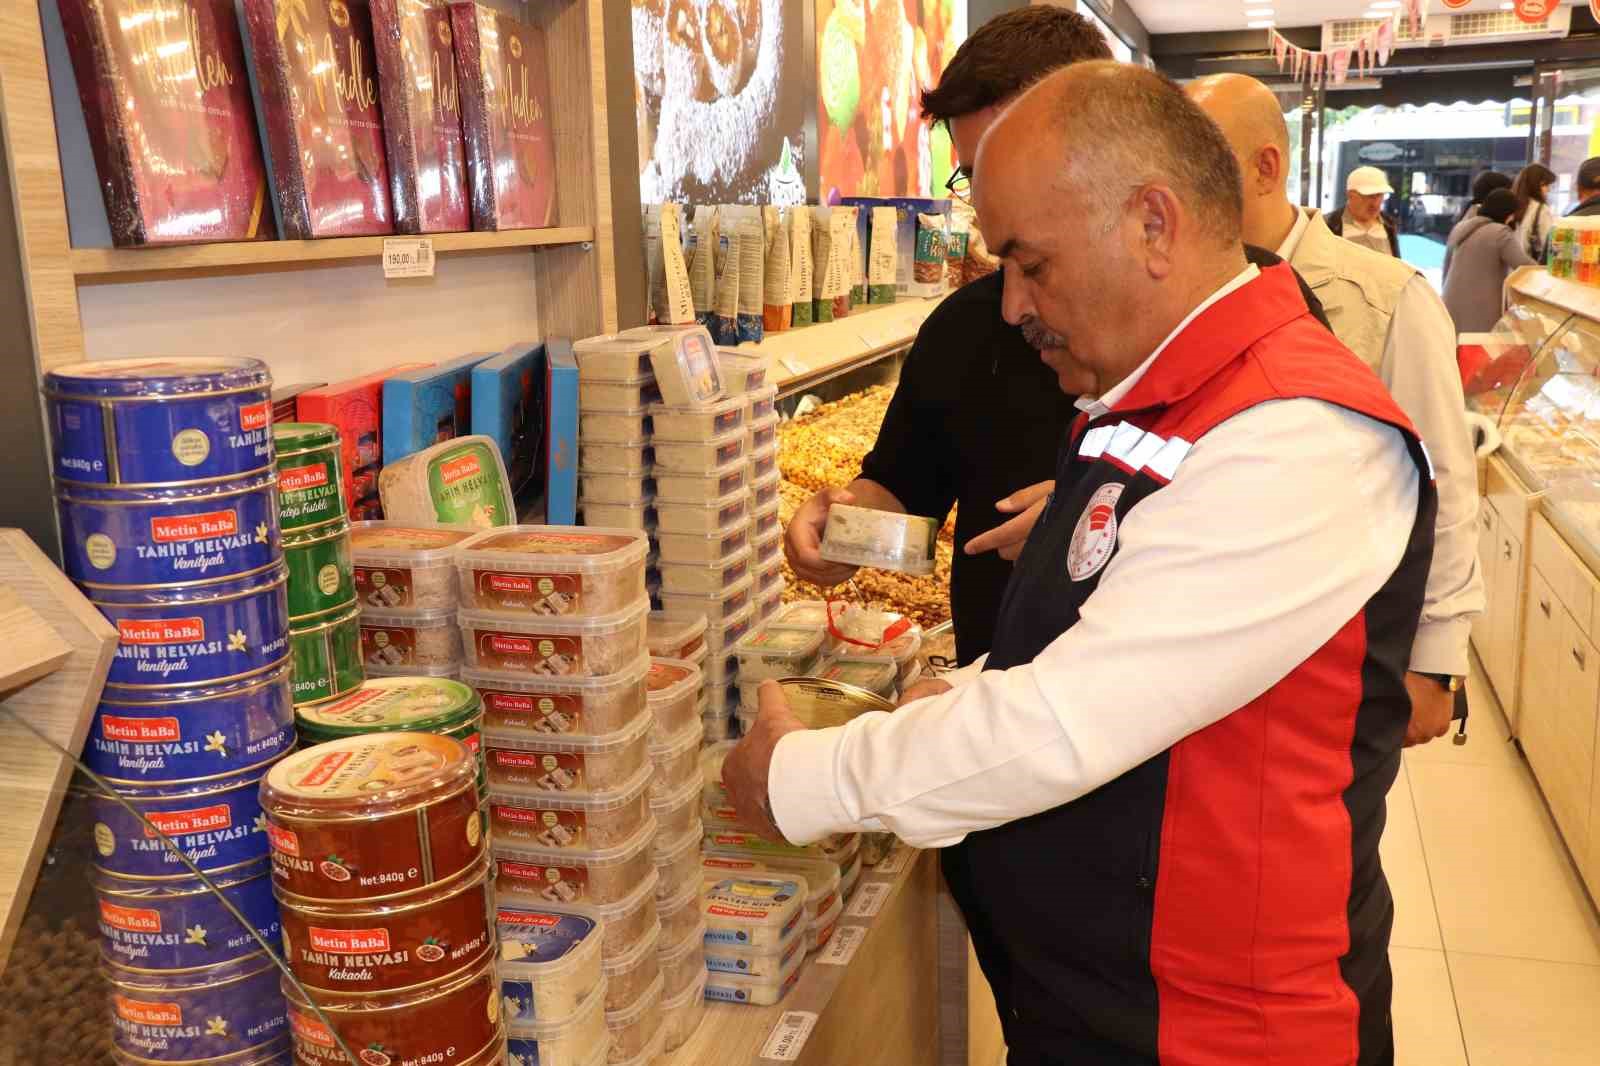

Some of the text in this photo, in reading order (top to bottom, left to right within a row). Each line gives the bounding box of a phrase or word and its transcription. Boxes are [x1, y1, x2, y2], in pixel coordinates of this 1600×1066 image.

[156, 520, 233, 538] Metin BaBa
[136, 533, 252, 558] TAHİN HELVASI
[173, 551, 225, 573] Vanilyalı
[122, 627, 200, 640] Metin BaBa
[156, 641, 223, 658] HELVASI
[136, 658, 189, 677] Vanilyalı
[104, 724, 176, 737] Metin BaBa
[95, 738, 200, 756] TAHİN HELVASI
[118, 756, 165, 774] Vanilyalı
[192, 814, 227, 827] BaBa
[186, 825, 248, 847] HELVASI
[124, 932, 180, 946] HELVASI
[313, 935, 385, 949] Metin BaBa
[302, 949, 409, 968] TAHİN HELVASI
[328, 967, 373, 981] Kakaolu
